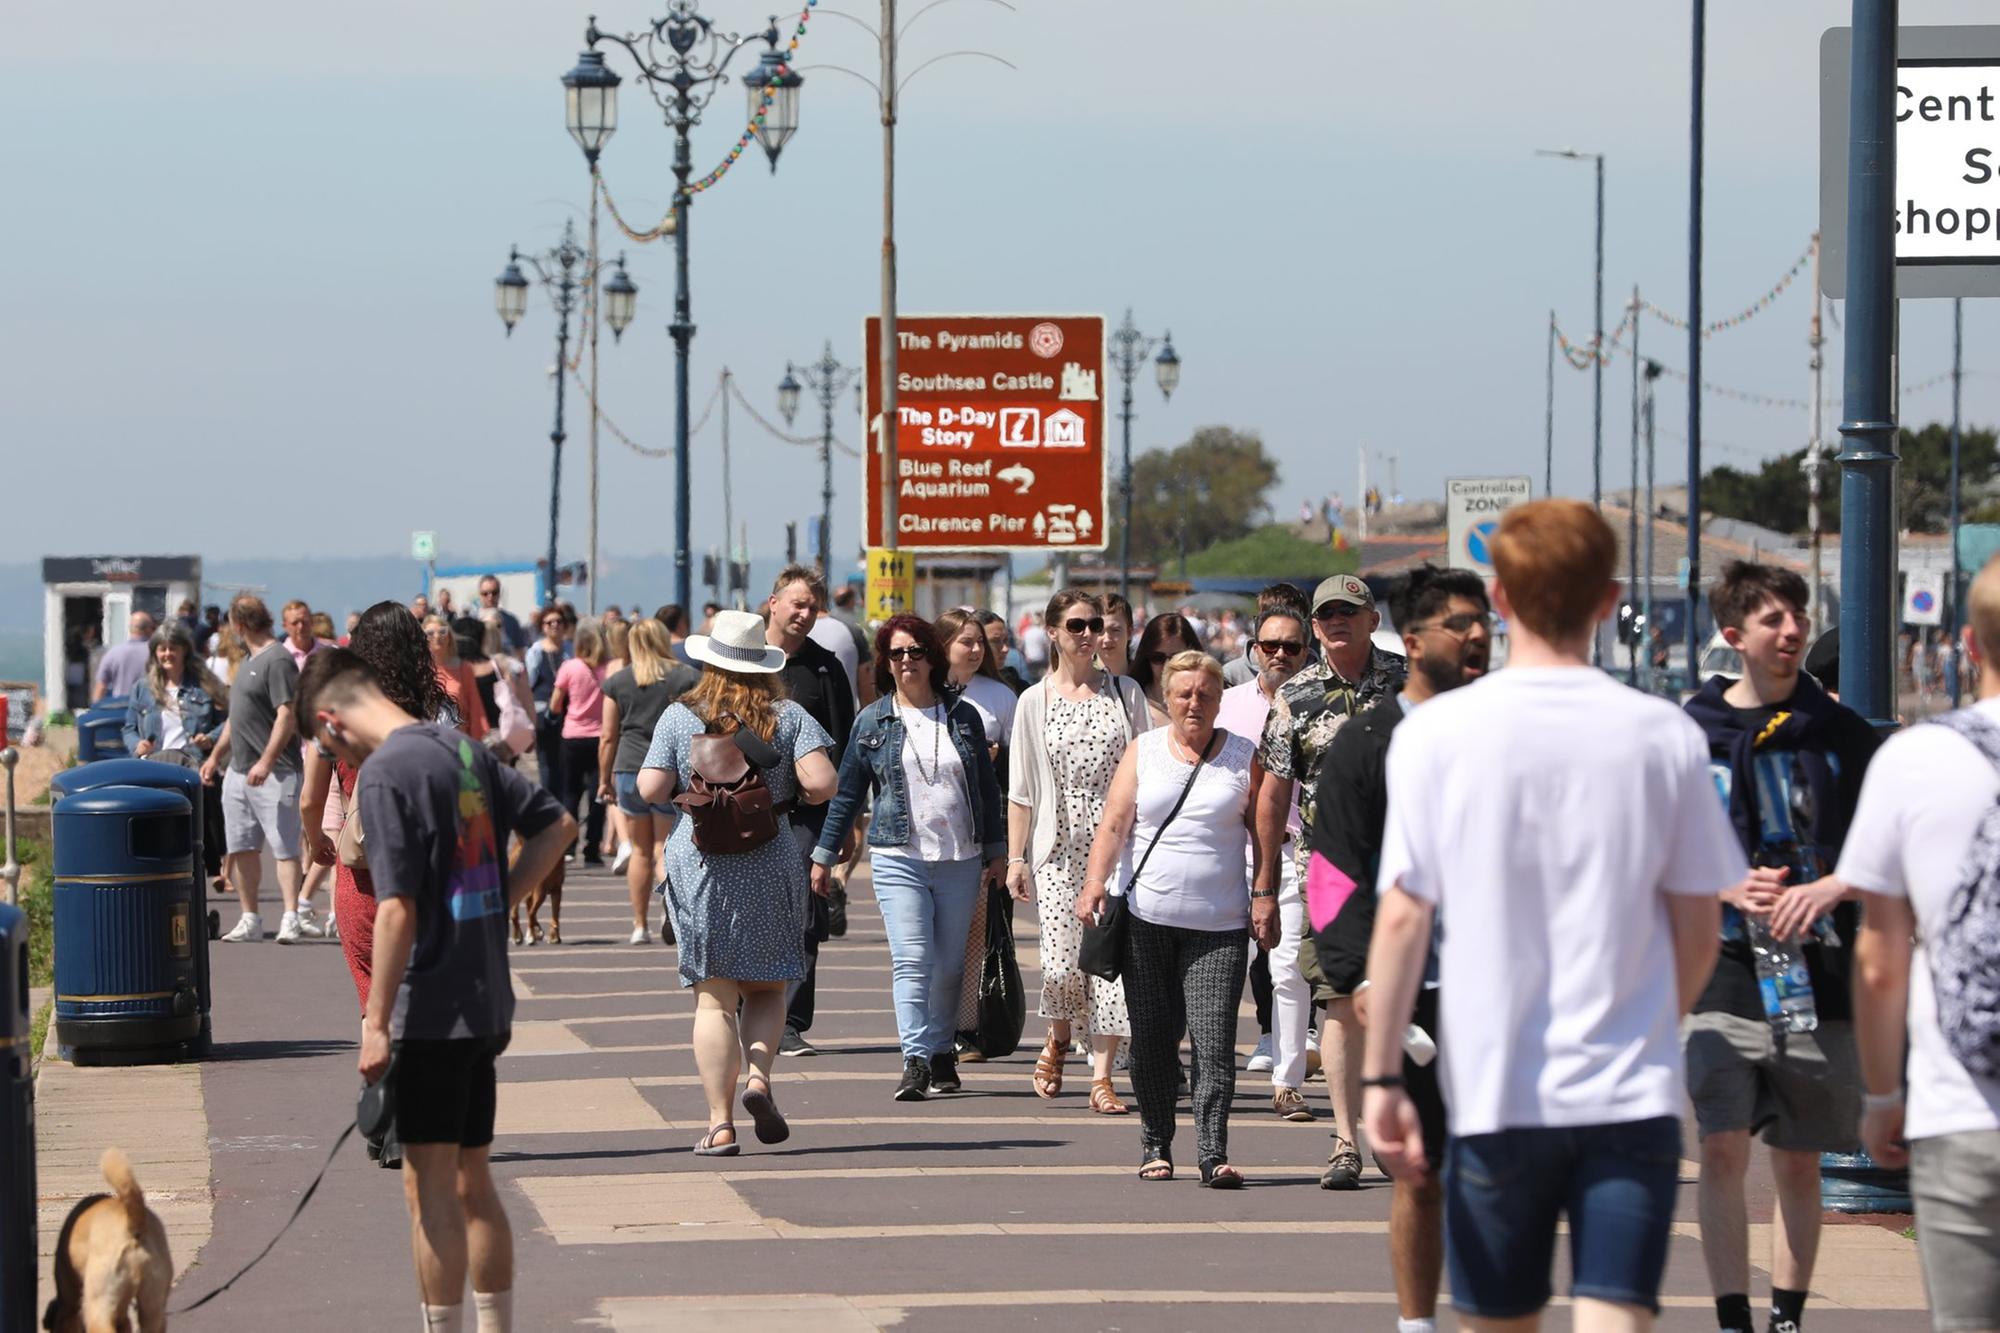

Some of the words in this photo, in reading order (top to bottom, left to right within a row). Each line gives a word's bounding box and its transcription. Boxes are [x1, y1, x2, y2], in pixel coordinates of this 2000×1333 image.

[1962, 147, 2000, 184] S
[1896, 200, 2000, 241] hop
[898, 332, 932, 350] The
[937, 331, 1024, 352] Pyramids
[898, 372, 986, 391] Southsea
[992, 372, 1054, 390] Castle
[898, 407, 932, 426] The
[938, 407, 996, 429] D-Day
[921, 428, 975, 449] Story
[899, 459, 943, 477] Blue
[948, 459, 992, 477] Reef
[900, 479, 990, 499] Aquarium
[1452, 482, 1526, 496] Controlled
[898, 513, 983, 533] Clarence
[988, 513, 1027, 532] Pier
